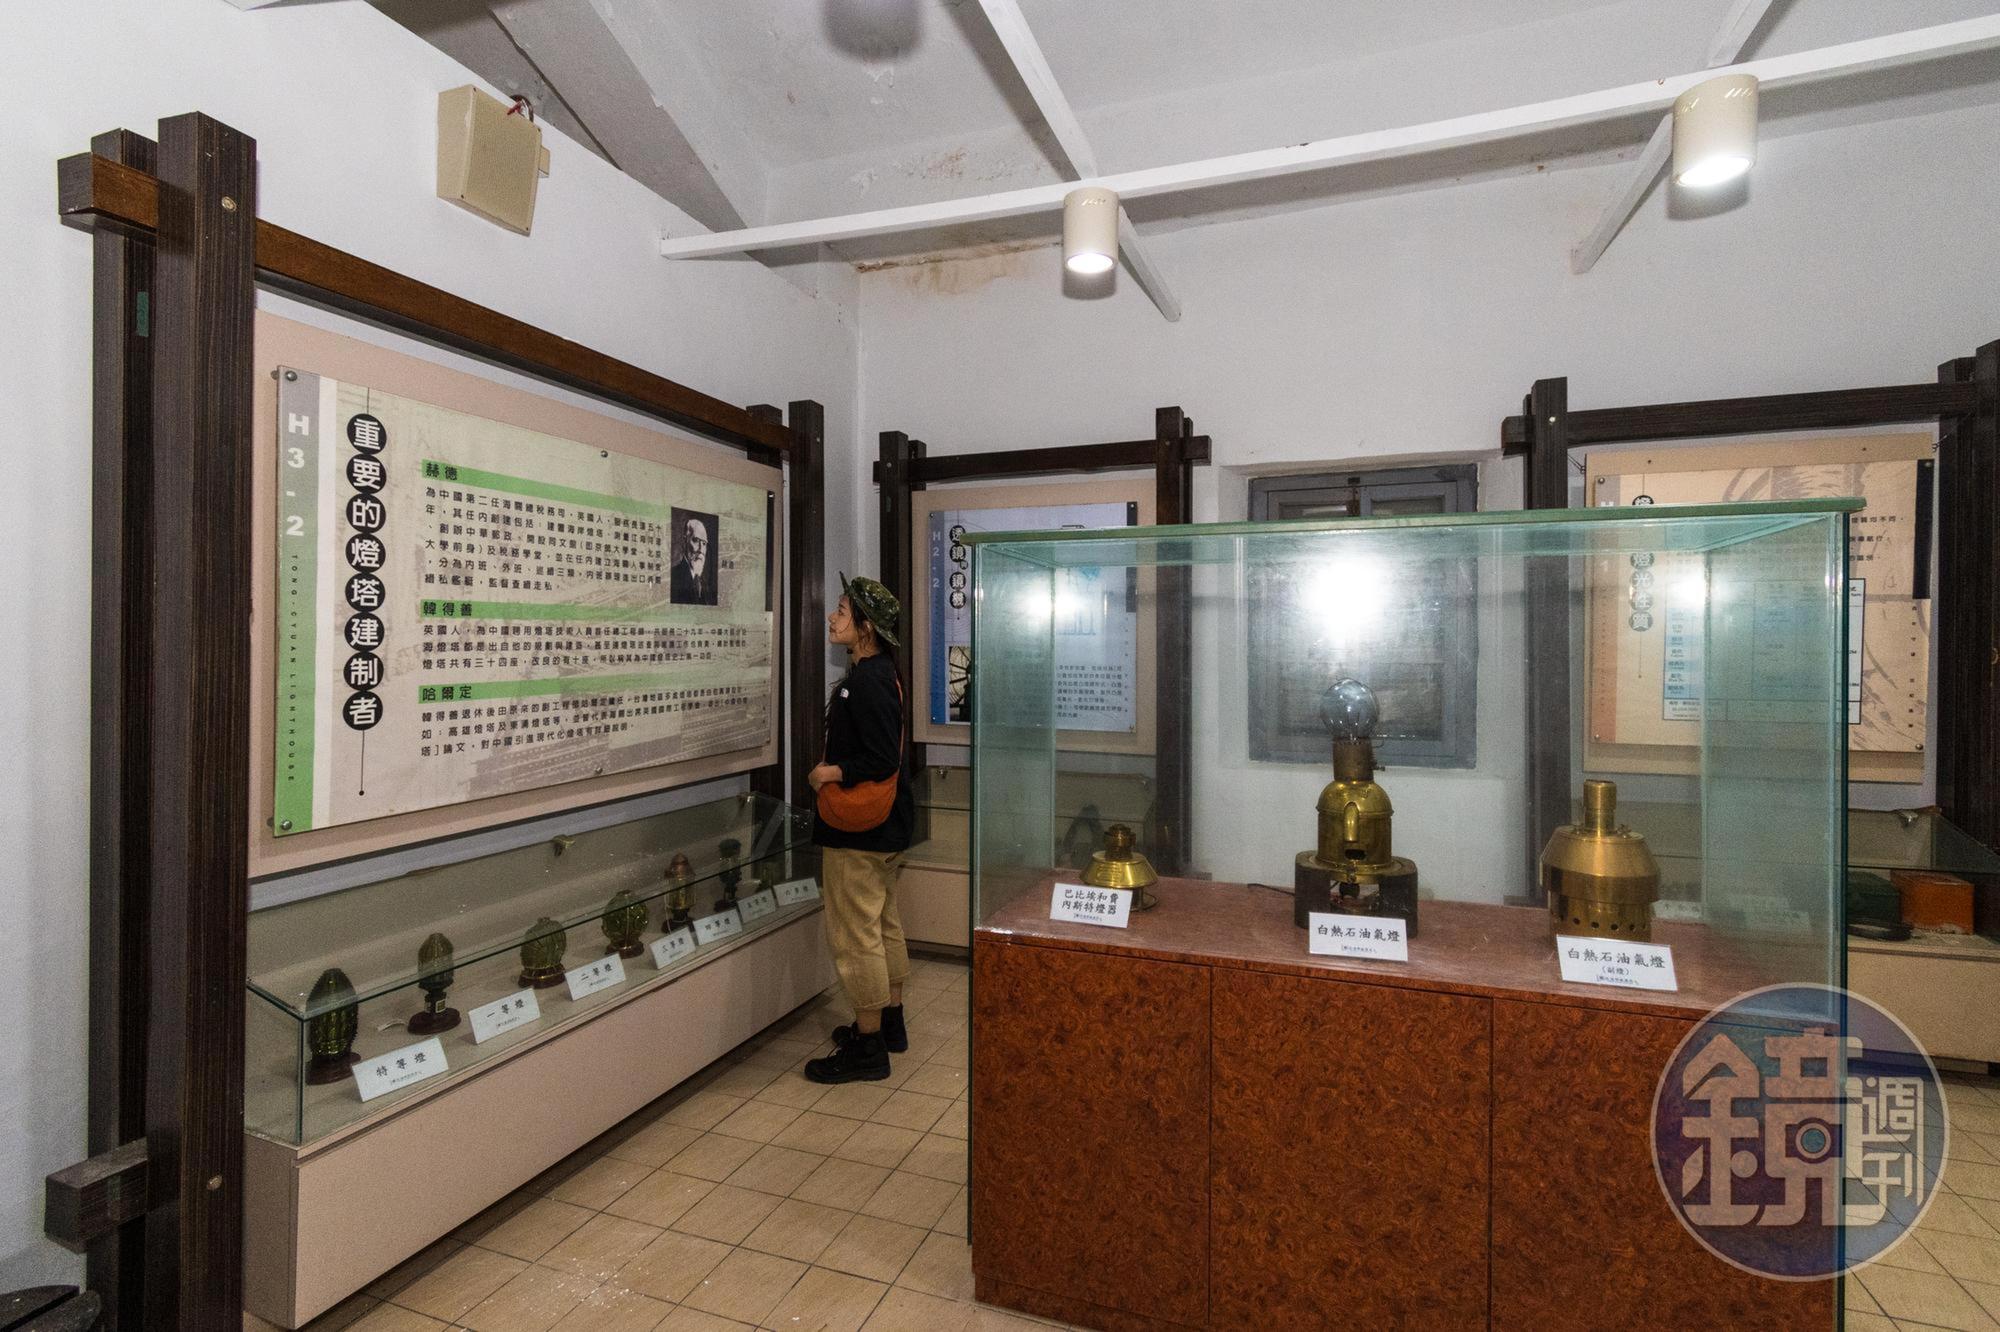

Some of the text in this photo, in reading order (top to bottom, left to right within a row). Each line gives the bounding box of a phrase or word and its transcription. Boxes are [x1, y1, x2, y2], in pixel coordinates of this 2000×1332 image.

[425, 461, 457, 481] 赫德
[348, 416, 384, 728] 重要的燈塔建制者
[422, 600, 473, 617] 韓得善
[421, 683, 472, 703] 哈爾定
[1064, 889, 1119, 904] 巴比埃和費
[1062, 900, 1117, 915] 內斯特燈器
[1318, 924, 1400, 942] 白熱石油氣燈
[1568, 947, 1665, 969] 白熱石油氣燈
[581, 963, 613, 981] 二等燈
[486, 999, 525, 1018] 一等燈
[376, 1052, 427, 1077] 特等燈
